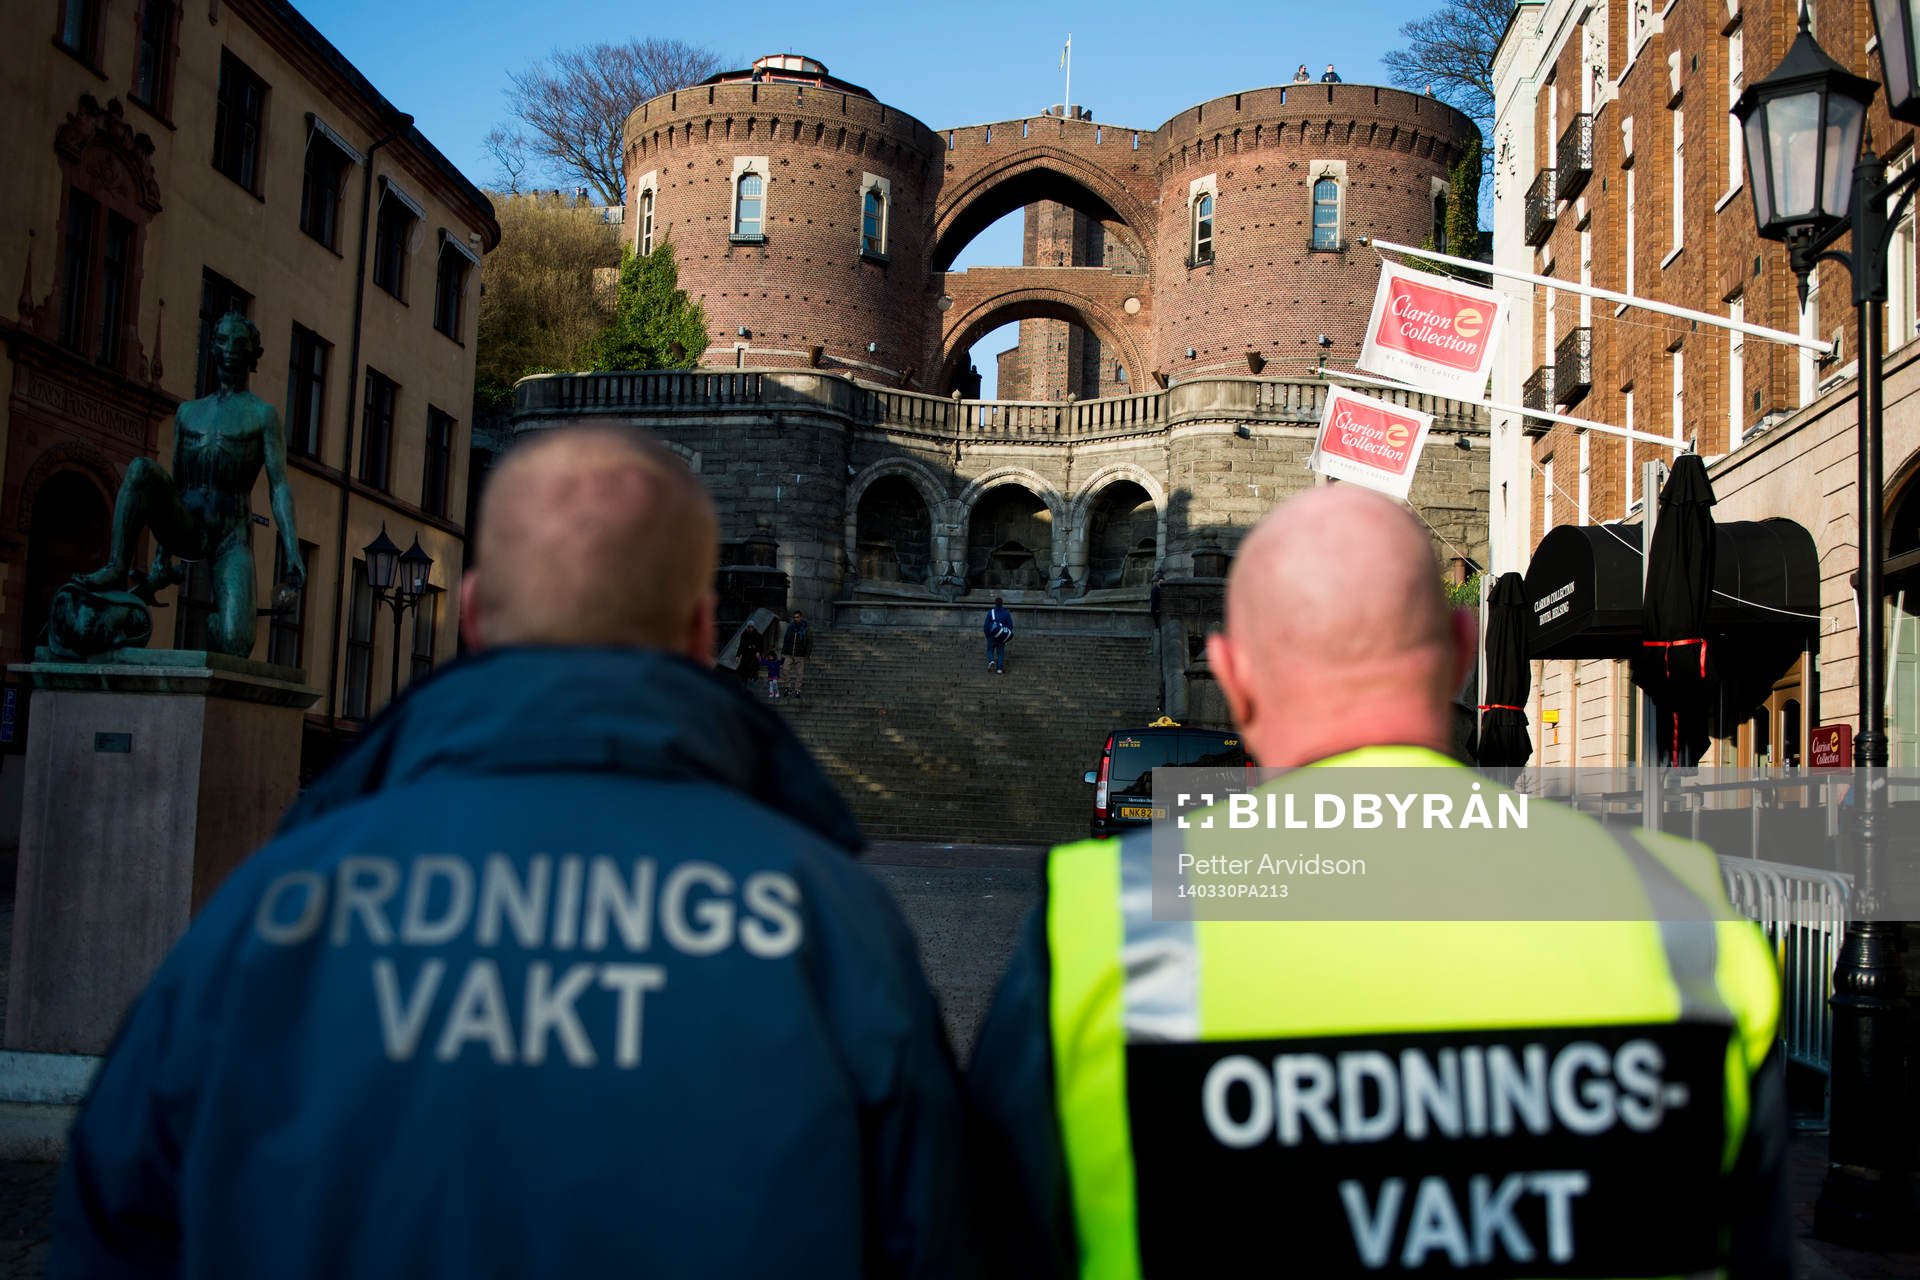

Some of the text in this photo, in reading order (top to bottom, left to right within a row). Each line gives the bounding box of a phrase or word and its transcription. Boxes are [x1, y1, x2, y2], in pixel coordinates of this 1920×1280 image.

[1391, 294, 1451, 330] Clarion
[1400, 322, 1477, 355] Collection
[1335, 411, 1384, 440] Clarion
[1341, 432, 1404, 462] Collection
[1534, 580, 1575, 613] CLARION COLLECTION
[1812, 736, 1831, 754] Clarion
[1816, 753, 1840, 765] Collection
[256, 853, 803, 958] ORDNINGS
[373, 958, 666, 1068] VAKT
[1201, 1040, 1688, 1148] ORDNINGS-
[1339, 1170, 1588, 1268] VAKT
